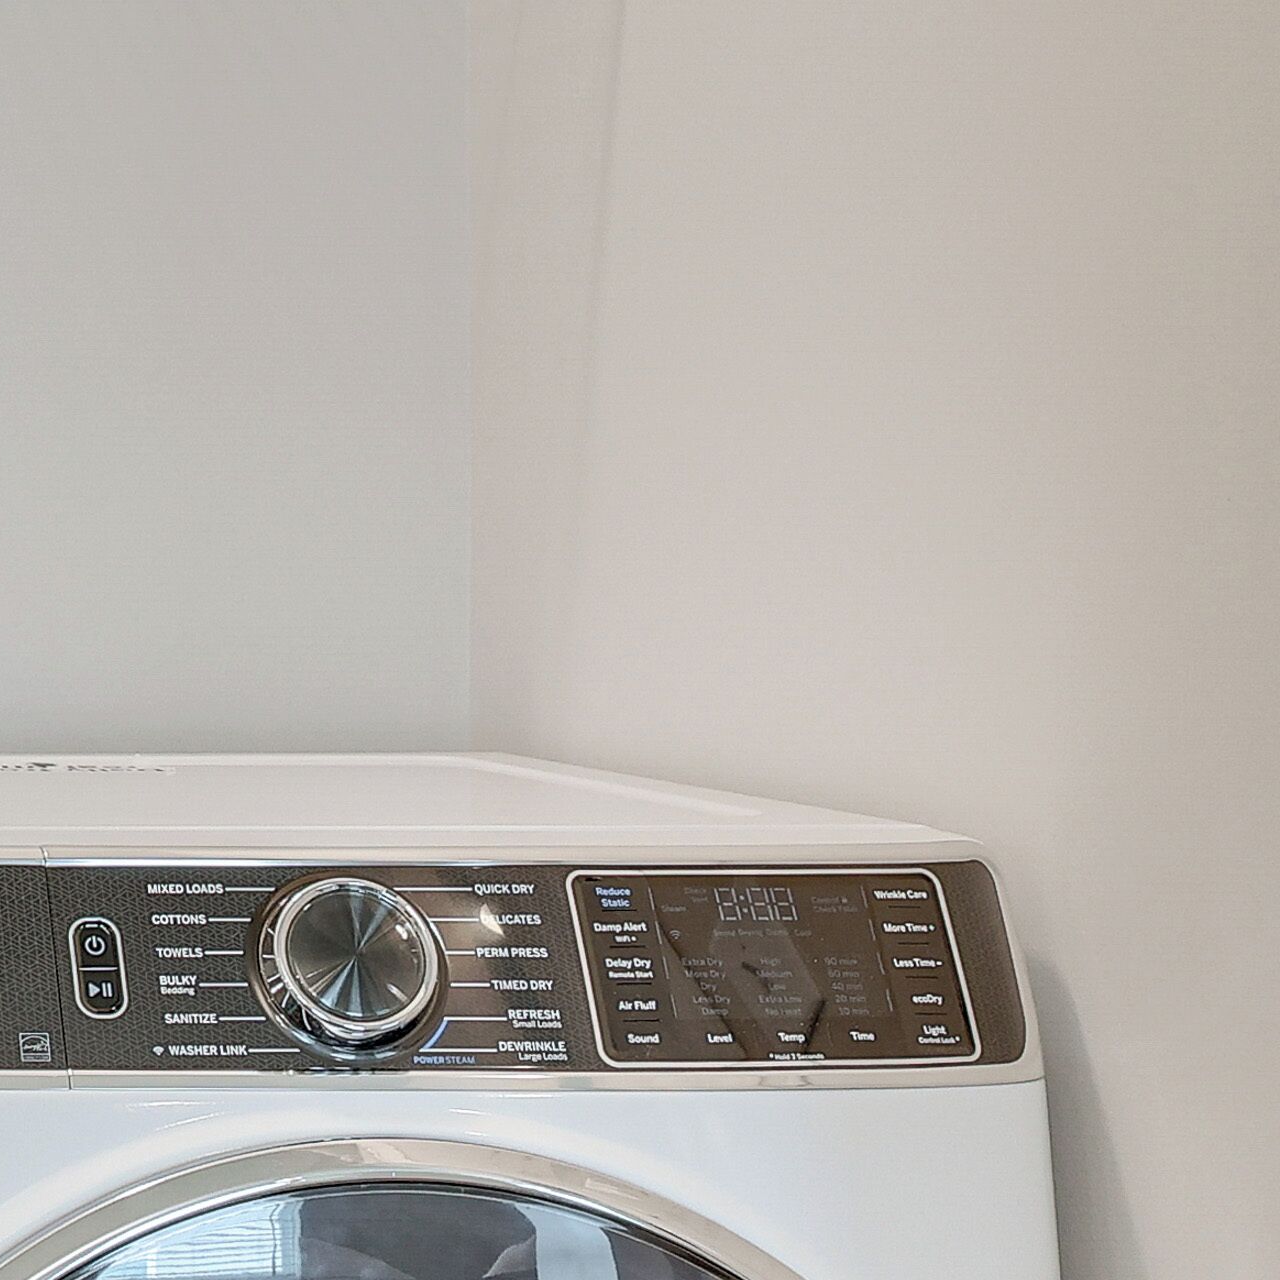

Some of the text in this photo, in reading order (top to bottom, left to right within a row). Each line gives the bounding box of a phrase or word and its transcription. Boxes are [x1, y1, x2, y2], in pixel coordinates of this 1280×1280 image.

[147, 883, 224, 894] MIXED LOADS
[474, 884, 535, 895] QUICK DRY
[595, 887, 631, 896] Reduce
[874, 889, 928, 899] Wrinkle Care
[600, 898, 630, 907] Static
[151, 915, 207, 925] COTTONS
[593, 922, 648, 933] Damp Alert
[905, 923, 928, 932] Time
[155, 948, 204, 958] TOWELS
[476, 948, 548, 958] PERM PRESS
[605, 958, 652, 969] Delay Dry
[893, 958, 914, 967] Less
[159, 976, 197, 986] BULKY
[491, 980, 553, 990] TIMED DRY
[160, 987, 195, 996] Bedding
[912, 994, 943, 1005] ecoDry
[618, 1001, 657, 1010] Air Fluff
[164, 1013, 218, 1024] SANITIZE
[508, 1010, 561, 1020] REFRESH
[512, 1020, 562, 1028] Small Loads
[923, 1025, 946, 1035] Light
[627, 1034, 660, 1044] Sound
[707, 1033, 733, 1043] Level
[777, 1032, 806, 1043] Temp
[850, 1031, 875, 1041] Time
[168, 1045, 248, 1056] WASHER LINK
[498, 1041, 567, 1052] DEWRINKLE
[518, 1052, 568, 1062] Large Loads
